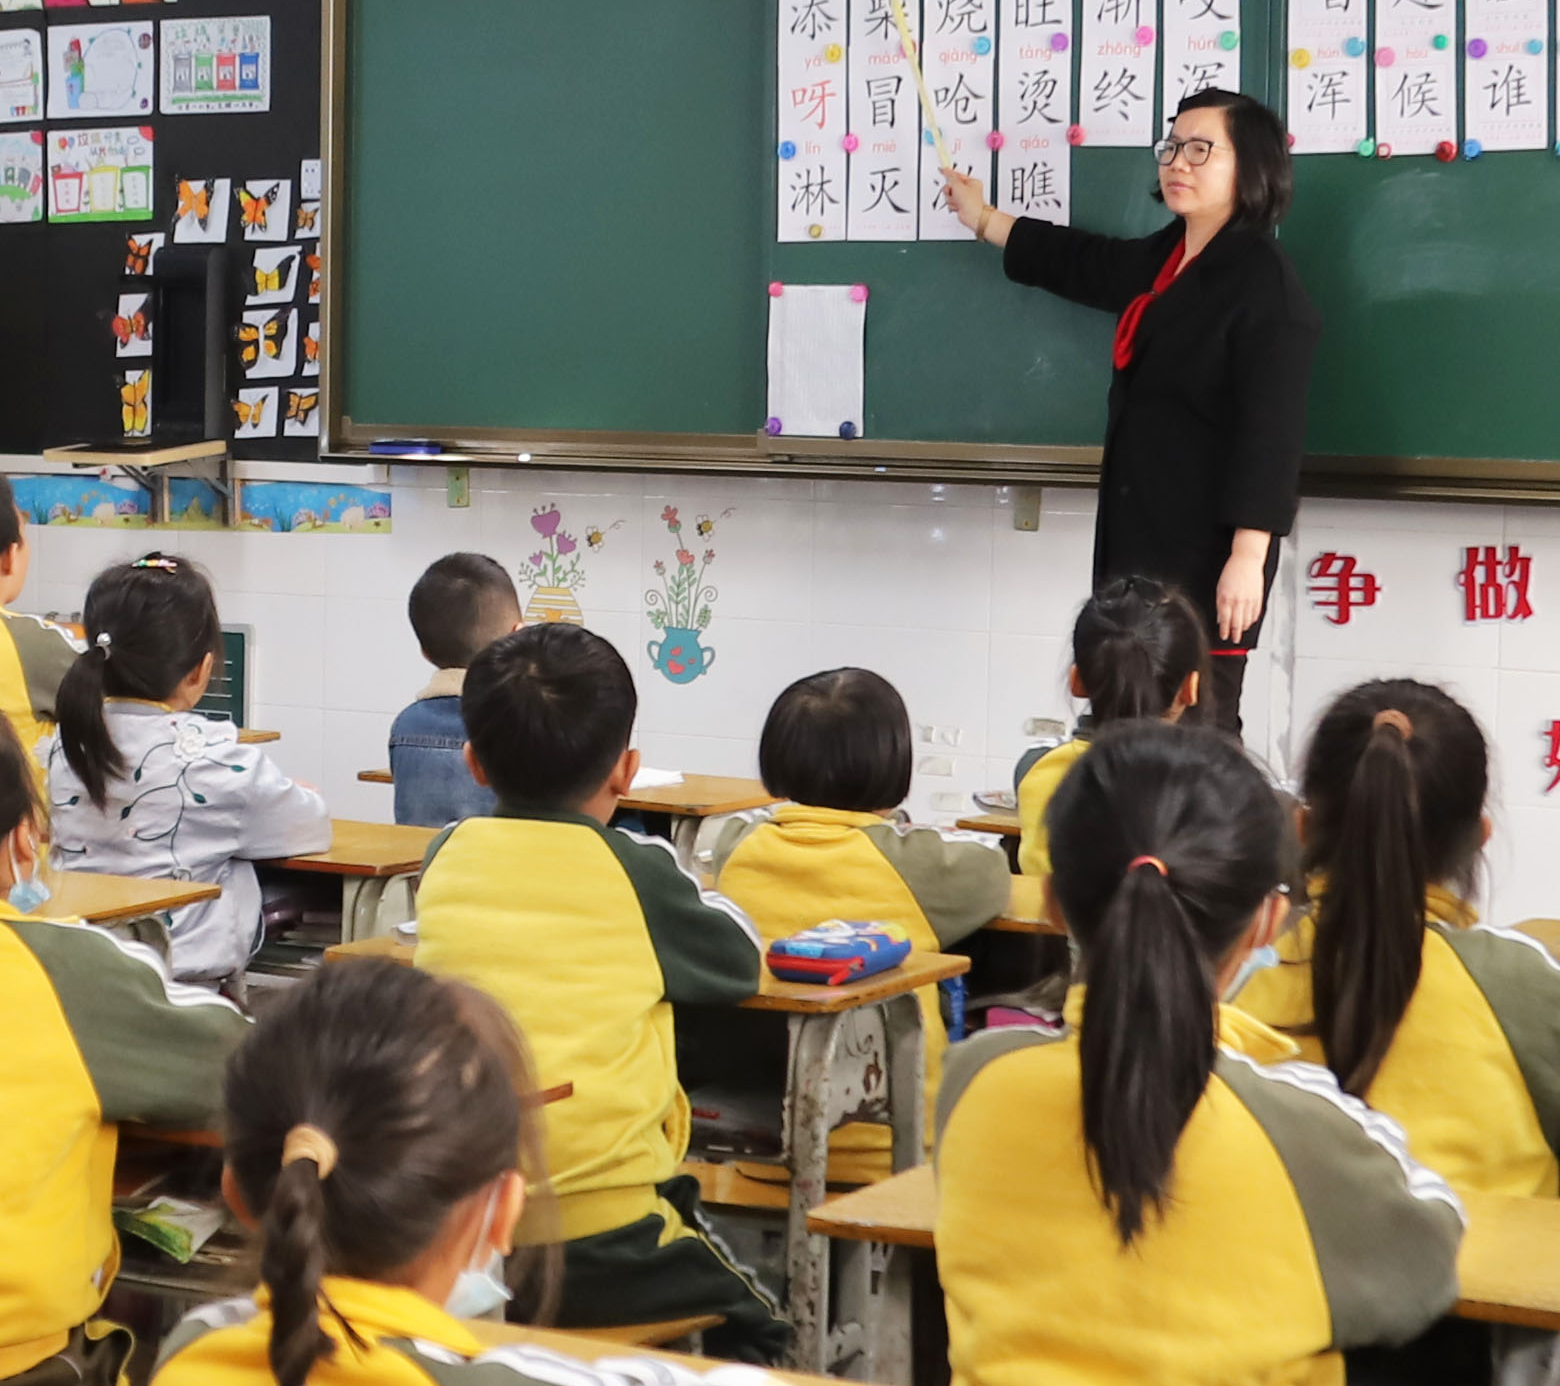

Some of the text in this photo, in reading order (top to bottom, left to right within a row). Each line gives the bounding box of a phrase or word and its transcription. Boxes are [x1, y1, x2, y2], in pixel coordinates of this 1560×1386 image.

[791, 79, 837, 131] 呀
[865, 75, 903, 129] 冒
[933, 72, 986, 126] 呛
[1016, 69, 1064, 126] 烫
[1092, 66, 1147, 122] 终
[1307, 70, 1352, 121] 浑
[1391, 71, 1444, 119] 候
[1482, 63, 1533, 117] 谁
[790, 164, 840, 218] 淋
[862, 166, 911, 215] 灭
[1010, 161, 1062, 212] 瞧
